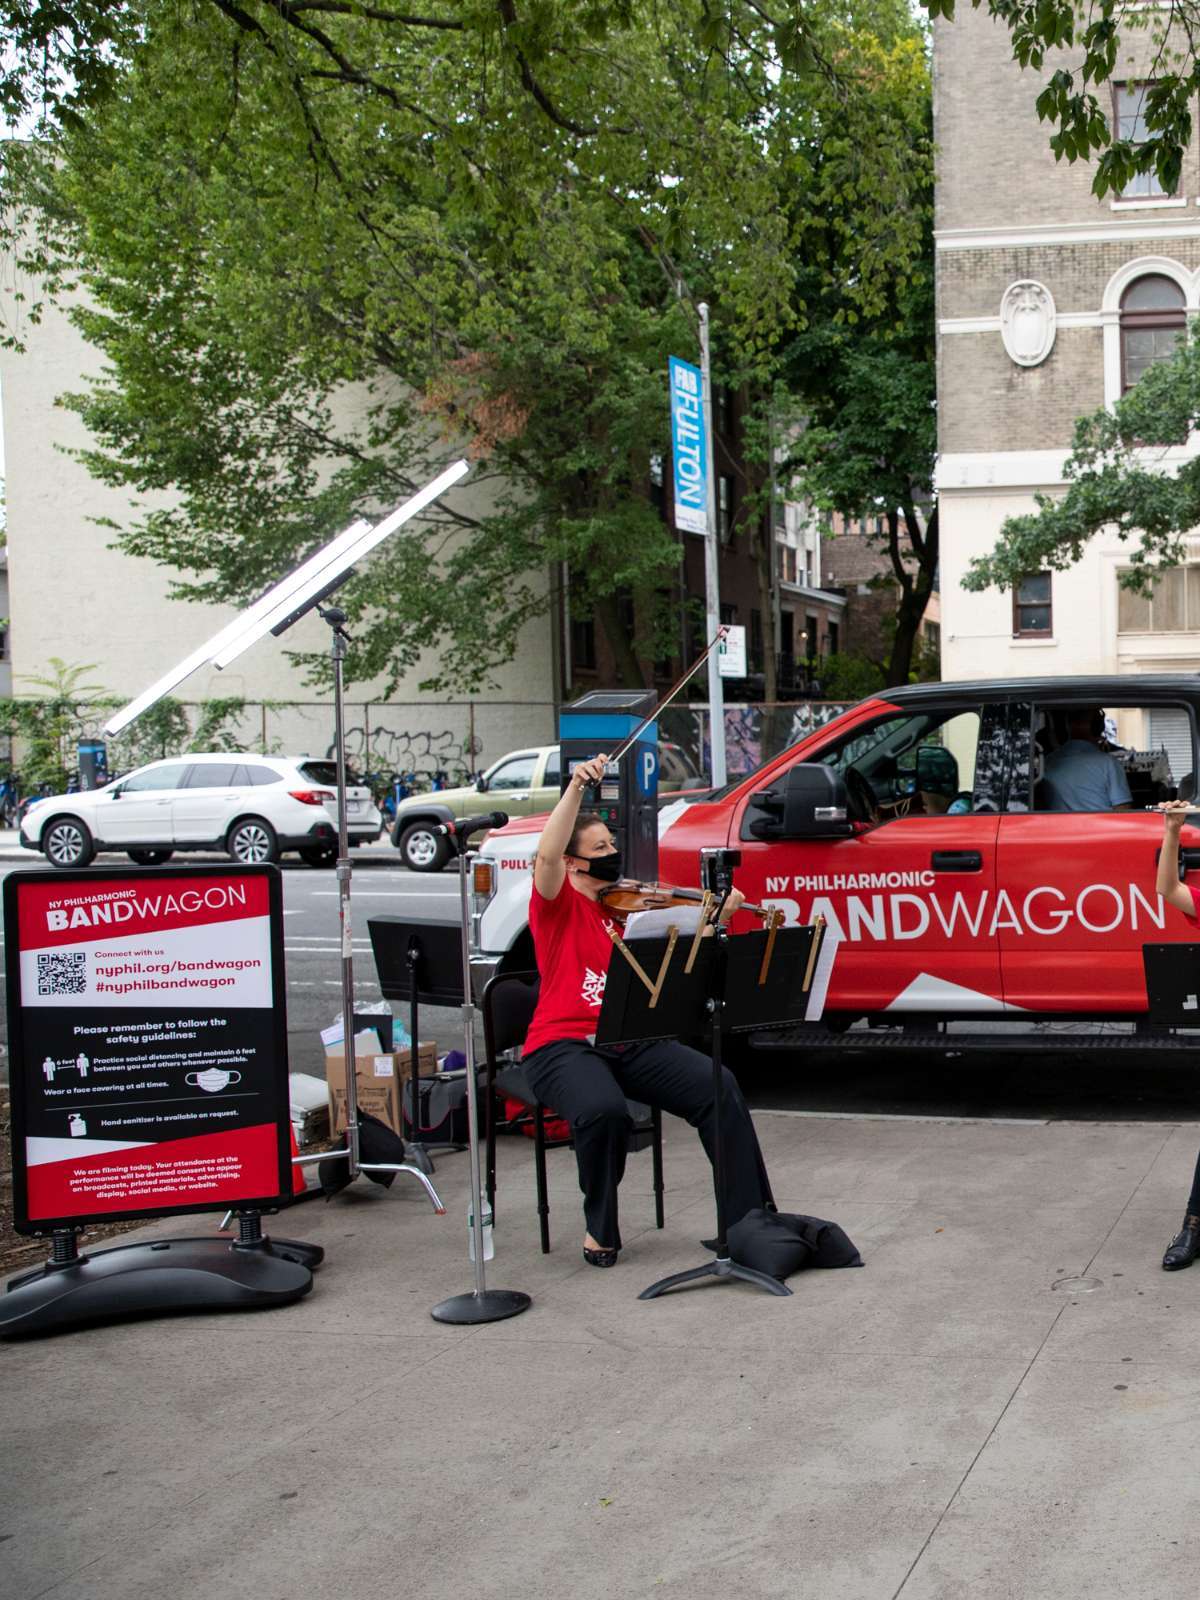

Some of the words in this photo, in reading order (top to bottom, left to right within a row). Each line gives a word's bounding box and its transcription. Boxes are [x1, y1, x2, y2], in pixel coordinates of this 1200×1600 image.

[675, 388, 701, 504] FULTON
[644, 752, 656, 790] P
[766, 877, 788, 892] NY
[794, 870, 935, 891] PHILHARMONIC
[46, 884, 246, 932] BANDWAGON
[49, 899, 63, 909] NY
[64, 889, 137, 907] PHILHARMONIC
[761, 883, 1166, 942] BANDWAGON
[94, 950, 132, 958] Connect
[134, 949, 152, 957] with
[95, 957, 261, 979] nyphil.org/bandwagon
[96, 976, 235, 993] #nyphilbandwagon
[581, 966, 600, 1002] NEW
[73, 1024, 108, 1035] Please
[111, 1022, 162, 1032] remember
[165, 1021, 176, 1029] to
[177, 1019, 208, 1029] follow
[210, 1018, 226, 1026] the
[106, 1034, 139, 1044] safety
[141, 1031, 197, 1043] guidelines:
[93, 1056, 124, 1064] Practice
[126, 1054, 147, 1062] social
[149, 1052, 184, 1061] distancing
[203, 1049, 234, 1057] maintain
[93, 1064, 125, 1072] between
[182, 1059, 216, 1067] whenever
[217, 1056, 248, 1065] possible.
[44, 1088, 65, 1096] Wear
[73, 1086, 91, 1094] face
[92, 1084, 125, 1093] covering
[101, 1119, 121, 1127] Hand
[164, 1113, 198, 1121] available
[209, 1110, 239, 1118] request.
[69, 1175, 119, 1185] performance
[145, 1170, 176, 1178] deemed
[176, 1167, 206, 1175] consent
[216, 1164, 242, 1173] appear
[73, 1169, 87, 1177] We
[101, 1166, 129, 1174] filming
[130, 1164, 154, 1172] today.
[173, 1158, 215, 1167] attendance
[128, 1187, 151, 1195] social
[188, 1181, 219, 1189] website.
[130, 1179, 158, 1188] printed
